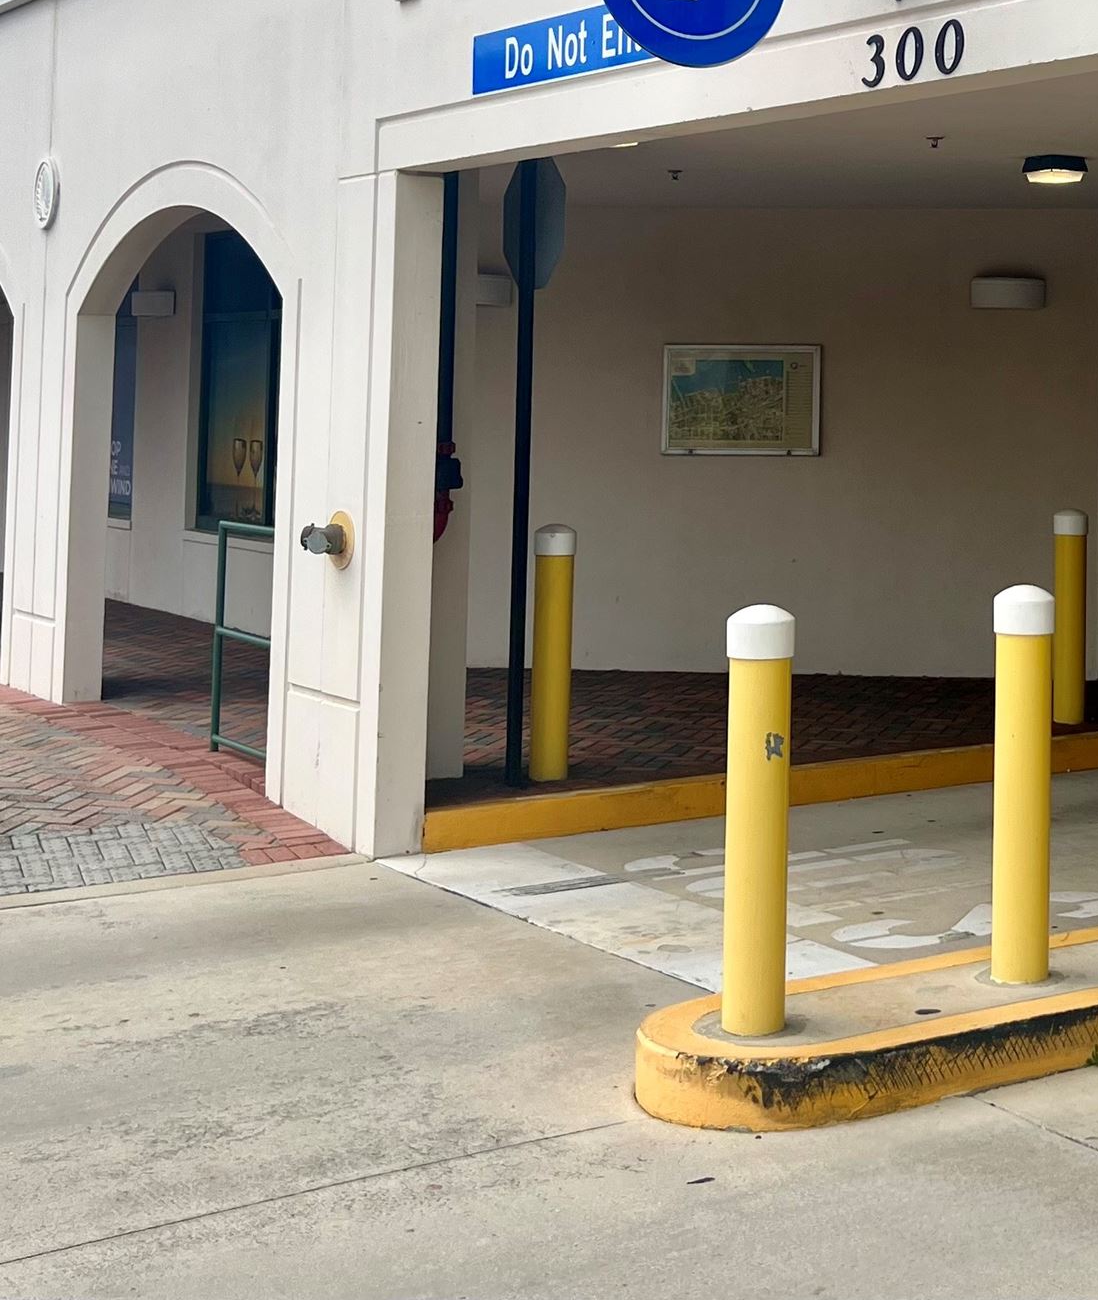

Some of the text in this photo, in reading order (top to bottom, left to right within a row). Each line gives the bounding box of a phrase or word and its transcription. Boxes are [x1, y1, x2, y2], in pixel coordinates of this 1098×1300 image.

[504, 36, 534, 80] Do
[546, 19, 588, 71] Not
[860, 18, 965, 88] 300
